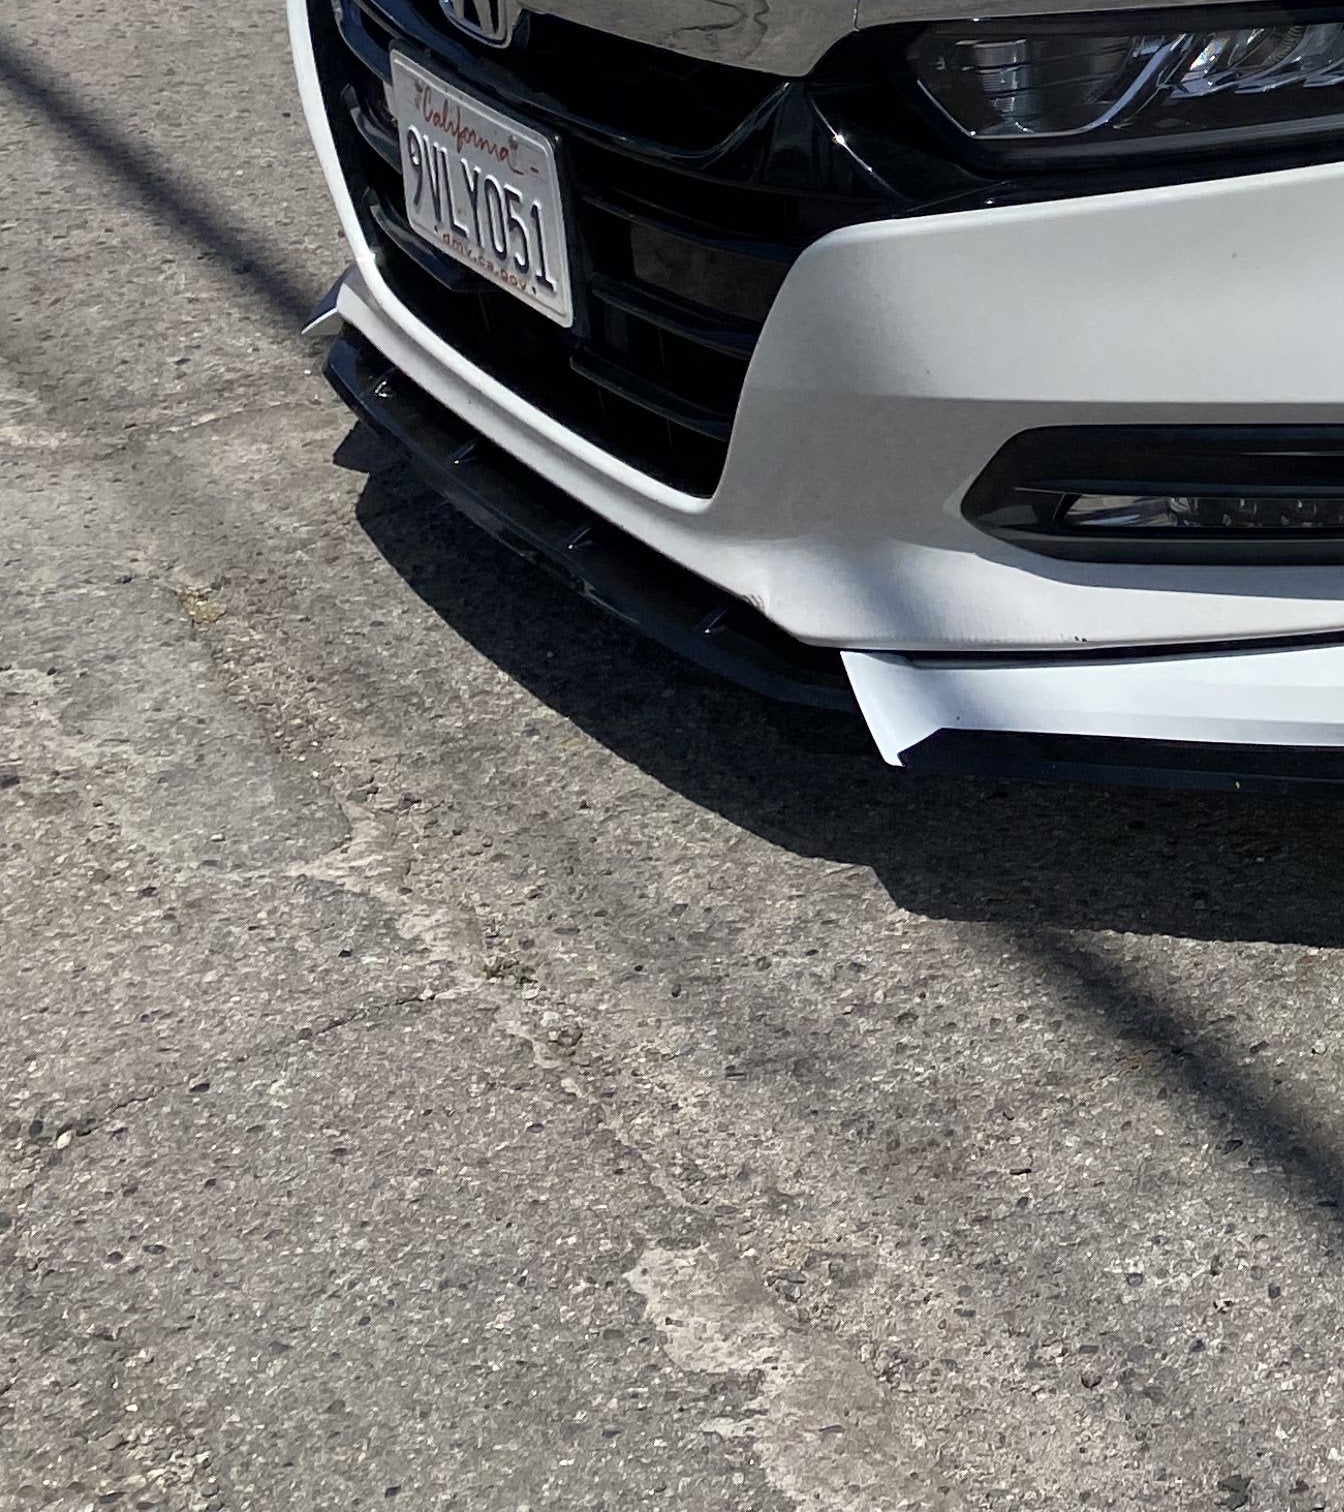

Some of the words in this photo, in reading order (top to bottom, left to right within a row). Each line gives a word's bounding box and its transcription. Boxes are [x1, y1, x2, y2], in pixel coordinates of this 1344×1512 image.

[421, 89, 524, 176] California
[406, 124, 558, 298] 9VLY051
[442, 232, 528, 292] dmv.ca.gov
